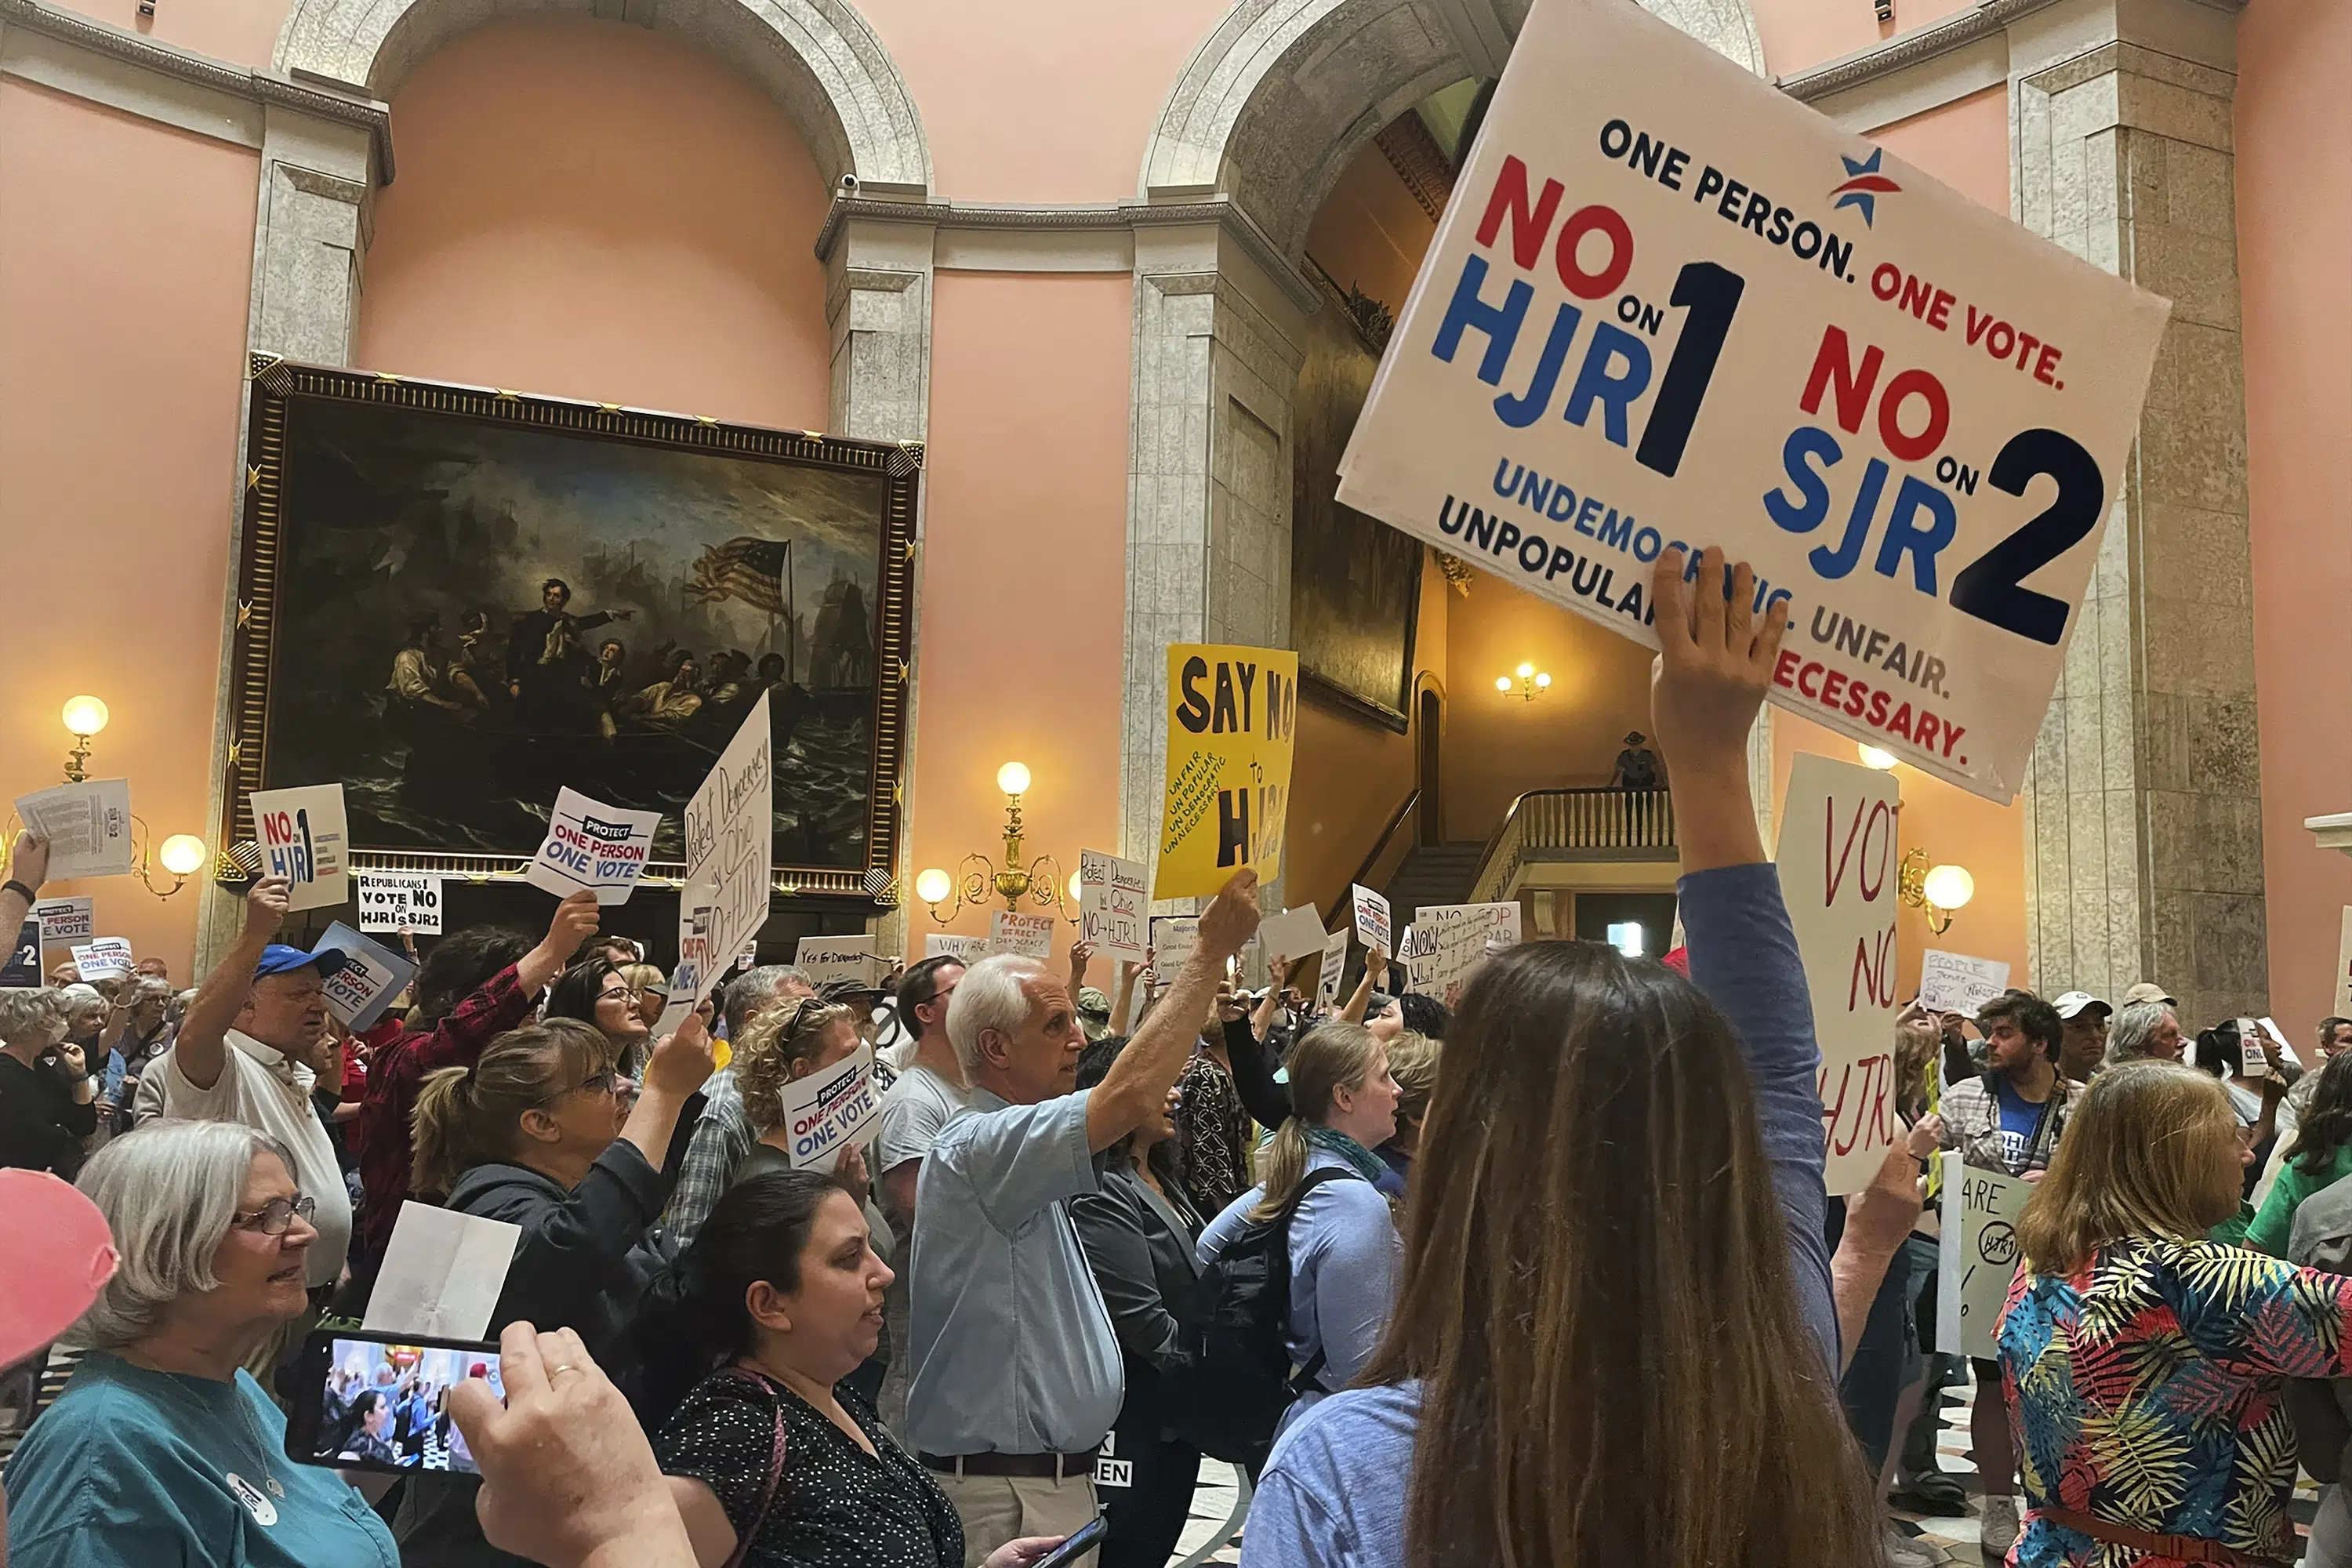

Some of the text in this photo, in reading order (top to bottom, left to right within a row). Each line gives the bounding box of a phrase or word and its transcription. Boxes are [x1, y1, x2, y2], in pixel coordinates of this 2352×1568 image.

[1475, 154, 1634, 299] NO
[1600, 119, 2064, 391] ONE PERSON. ONE VOTE.
[1617, 295, 1664, 336] ON
[1800, 324, 1950, 462] NO
[1936, 456, 1980, 496] ON
[1439, 495, 1655, 626] UNPOPULA
[1811, 605, 1950, 699] UNFAIR.
[1176, 655, 1294, 743] SAY NO
[1250, 753, 1263, 783] to
[263, 811, 292, 845] NO
[555, 824, 644, 861] ONE PERSON
[586, 820, 630, 837] PROTECT
[546, 841, 639, 879] ONE VOTE
[1825, 796, 1898, 907] VO
[362, 890, 437, 908] VOTE NO
[395, 904, 407, 914] ON
[1110, 888, 1134, 911] Ohio
[1357, 905, 1371, 917] ONE
[47, 915, 89, 925] PERSON
[56, 924, 89, 935] VOTE
[408, 913, 440, 927] SJR2
[1000, 913, 1054, 931] PROTECT
[1002, 928, 1037, 937] DIRECT
[1083, 910, 1100, 941] NO
[78, 952, 100, 960] ONE
[939, 939, 967, 953] WHY
[81, 960, 108, 969] ONE
[326, 978, 365, 1008] VOTE
[337, 969, 373, 998] ERSON
[820, 1069, 855, 1102] PROTECT
[793, 1108, 825, 1135] ONE
[797, 1090, 873, 1156] ONE VOTE
[1962, 1178, 2006, 1215] ARE
